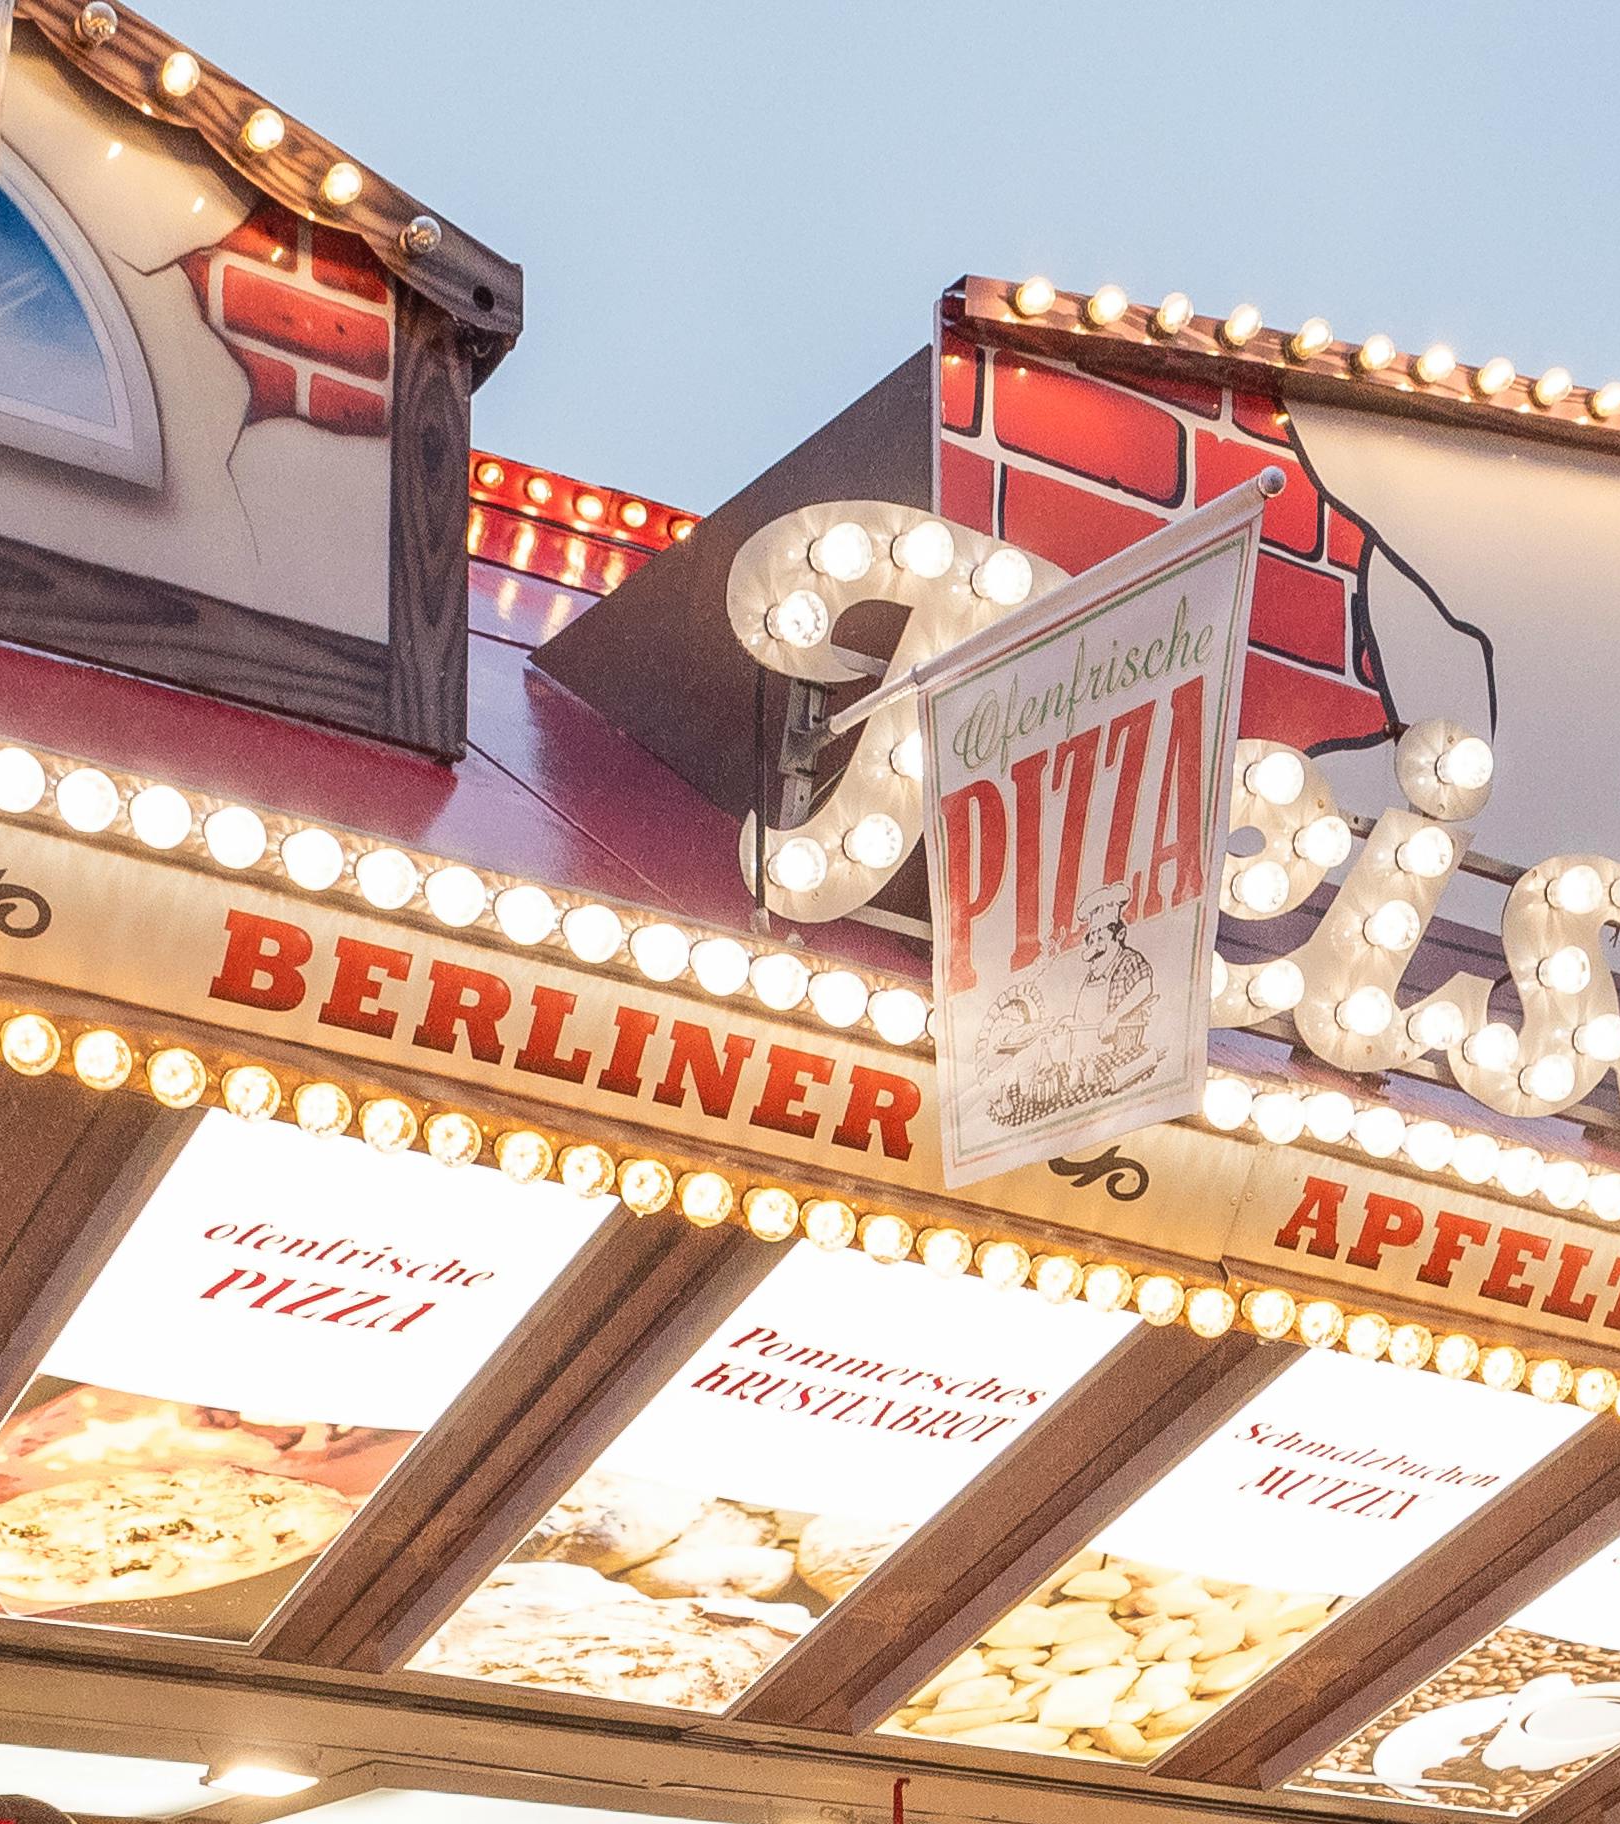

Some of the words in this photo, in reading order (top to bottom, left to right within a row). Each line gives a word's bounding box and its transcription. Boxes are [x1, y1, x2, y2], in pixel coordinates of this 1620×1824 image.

[939, 674, 1209, 1000] PIZZA
[208, 907, 923, 1163] BERLINER
[203, 1219, 498, 1292] ofenfrische
[199, 1266, 437, 1337] PIZZA
[690, 1361, 1018, 1443] KRUSTENBROT
[727, 1326, 1049, 1408] Pommersches
